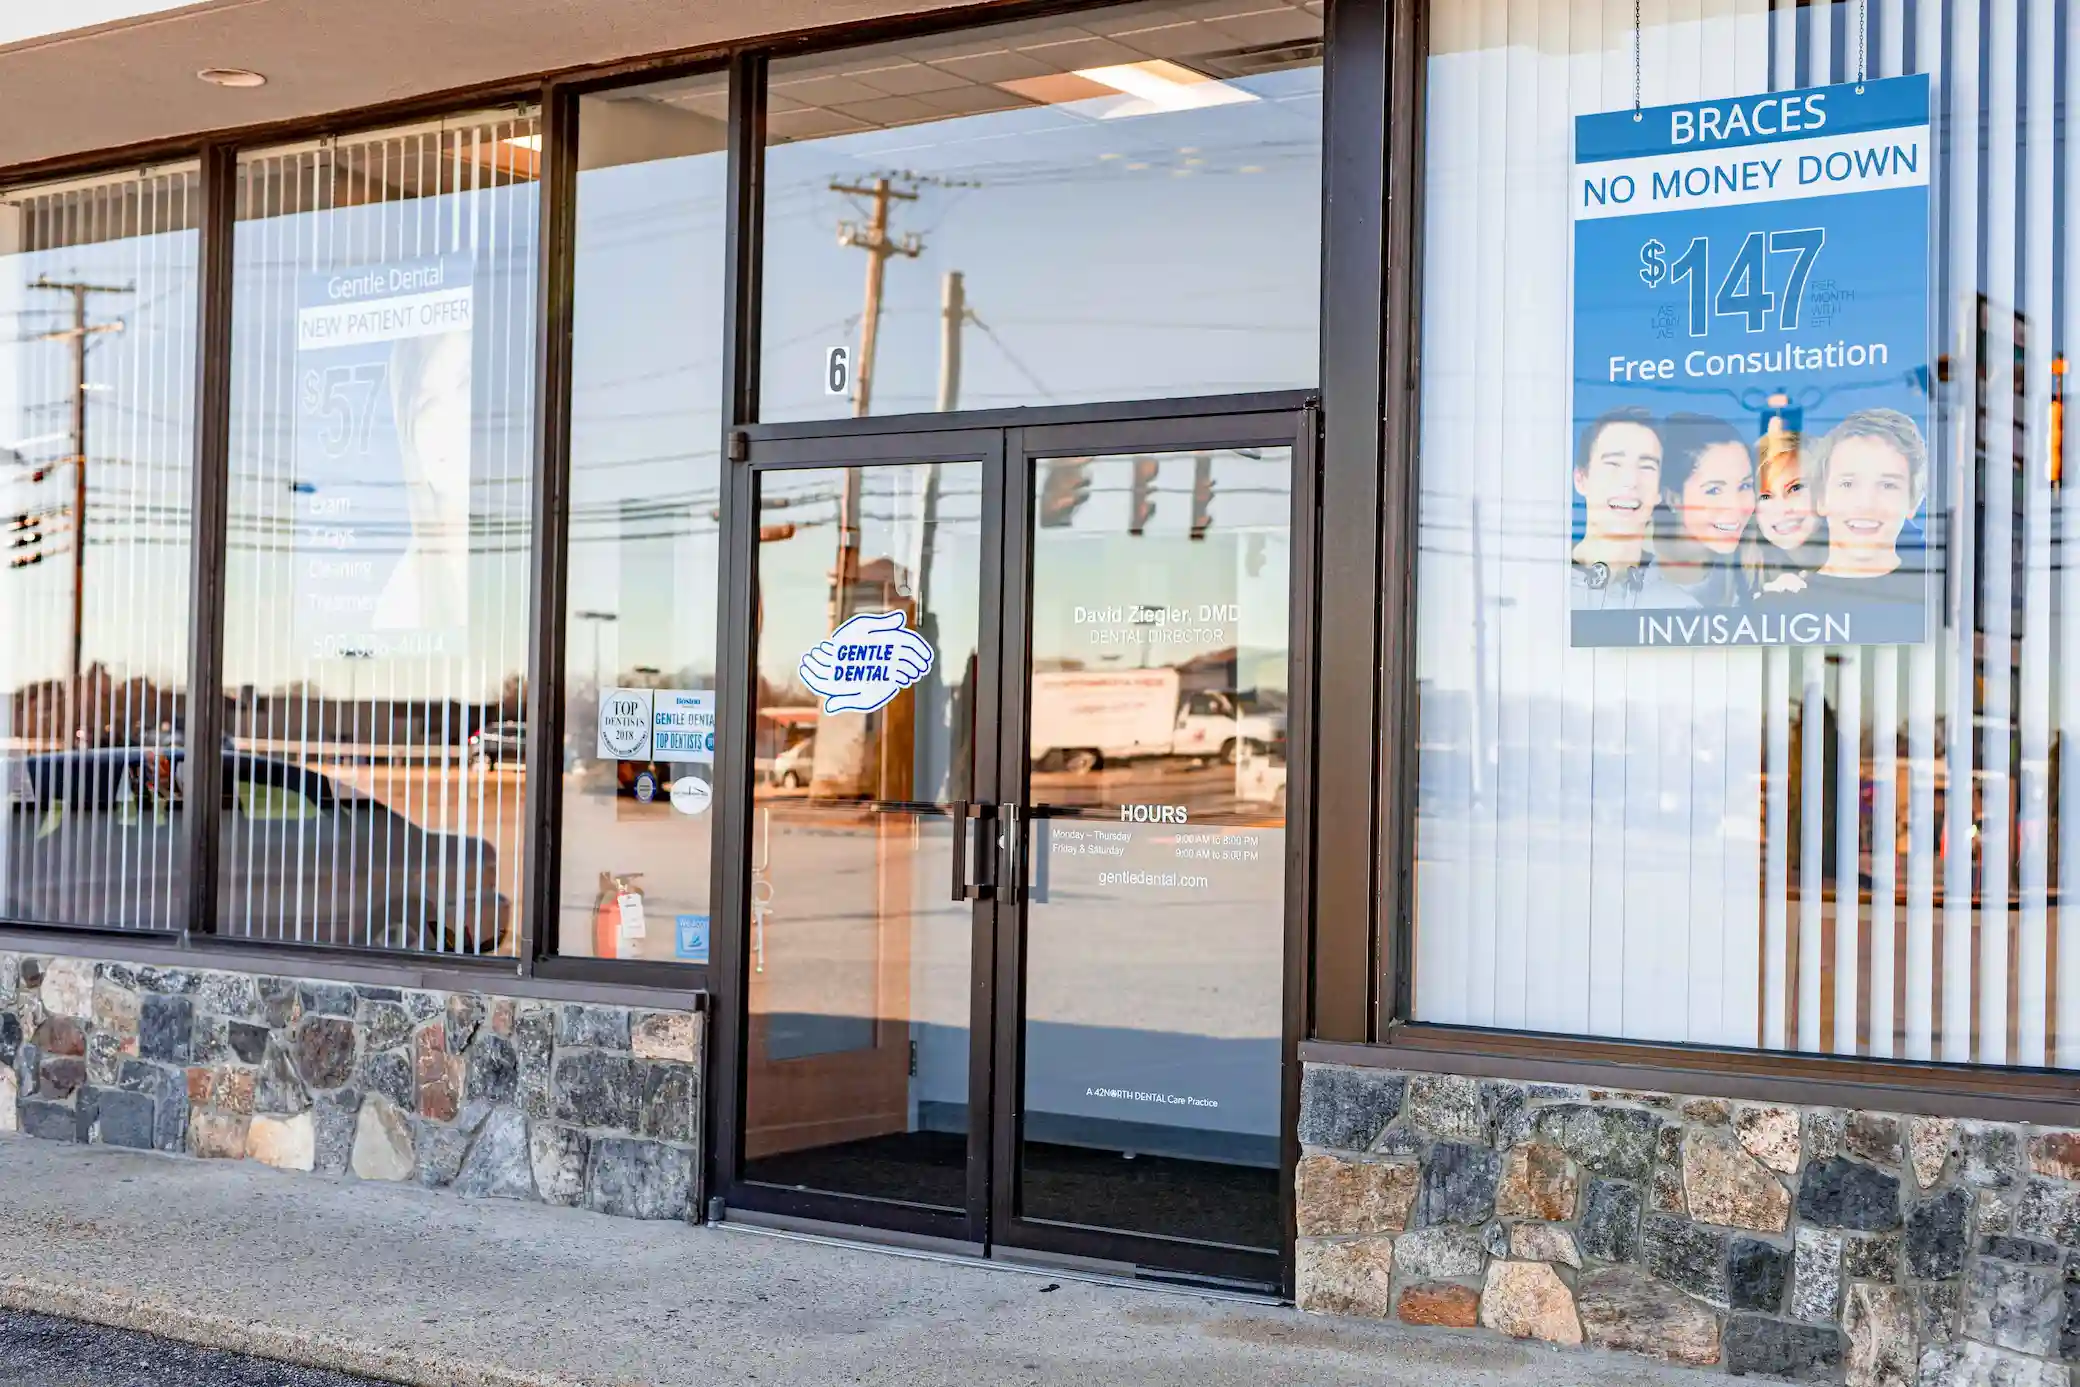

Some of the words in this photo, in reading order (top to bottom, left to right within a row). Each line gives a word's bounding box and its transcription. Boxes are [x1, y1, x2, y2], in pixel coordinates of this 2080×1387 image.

[1671, 93, 1826, 145] BRACES
[1584, 174, 1635, 207] NO
[1653, 158, 1782, 200] MONEY
[1799, 143, 1917, 185] DOWN
[328, 270, 385, 299] Gentle
[389, 257, 444, 292] Dental
[1640, 227, 1825, 337] $147
[1811, 280, 1837, 291] PER
[1811, 290, 1855, 302] MONTH
[303, 316, 342, 339] NEW
[348, 306, 414, 334] PATIENT
[420, 298, 470, 326] OFFER
[1657, 305, 1674, 316] AS
[1651, 316, 1680, 329] LOW
[1655, 329, 1674, 339] AS
[1609, 356, 1675, 382] Free
[1685, 340, 1888, 377] Consultation
[830, 348, 847, 392] 6
[302, 361, 389, 459] $57
[1074, 606, 1122, 624] David
[1128, 605, 1192, 627] Ziegler,
[1199, 604, 1241, 622] DMD
[1090, 629, 1145, 644] DENTAL
[1149, 628, 1225, 644] DIRECTOR
[1638, 613, 1850, 645] INVISALIGN
[837, 644, 894, 661] GENTLE
[834, 665, 890, 682] DENTAL
[613, 701, 638, 716] TOP
[605, 717, 645, 728] DENTISTS
[656, 712, 685, 725] GENTLE
[616, 730, 634, 741] 2018
[656, 732, 669, 748] TOP
[671, 732, 702, 749] DENTISTS
[1121, 804, 1188, 823] HOURS
[1052, 829, 1085, 840] Monday
[1094, 830, 1132, 843] Thursday
[1175, 834, 1194, 844] 9:00
[1195, 834, 1210, 844] AM
[1212, 835, 1220, 844] to
[1244, 836, 1259, 846] PM
[1052, 843, 1077, 855] Friday
[1079, 844, 1085, 853] &
[1088, 844, 1125, 856] Saturday
[1175, 848, 1194, 858] 9:00
[1196, 849, 1210, 859] AM
[1212, 850, 1221, 859] to
[1244, 850, 1259, 860] PM
[1099, 871, 1208, 888] gentledental.com
[1086, 1087, 1093, 1096] A
[1094, 1087, 1133, 1100] 42NORTH
[1135, 1091, 1167, 1103] DENTAL
[1168, 1094, 1186, 1105] Care
[1188, 1096, 1219, 1108] Practice
